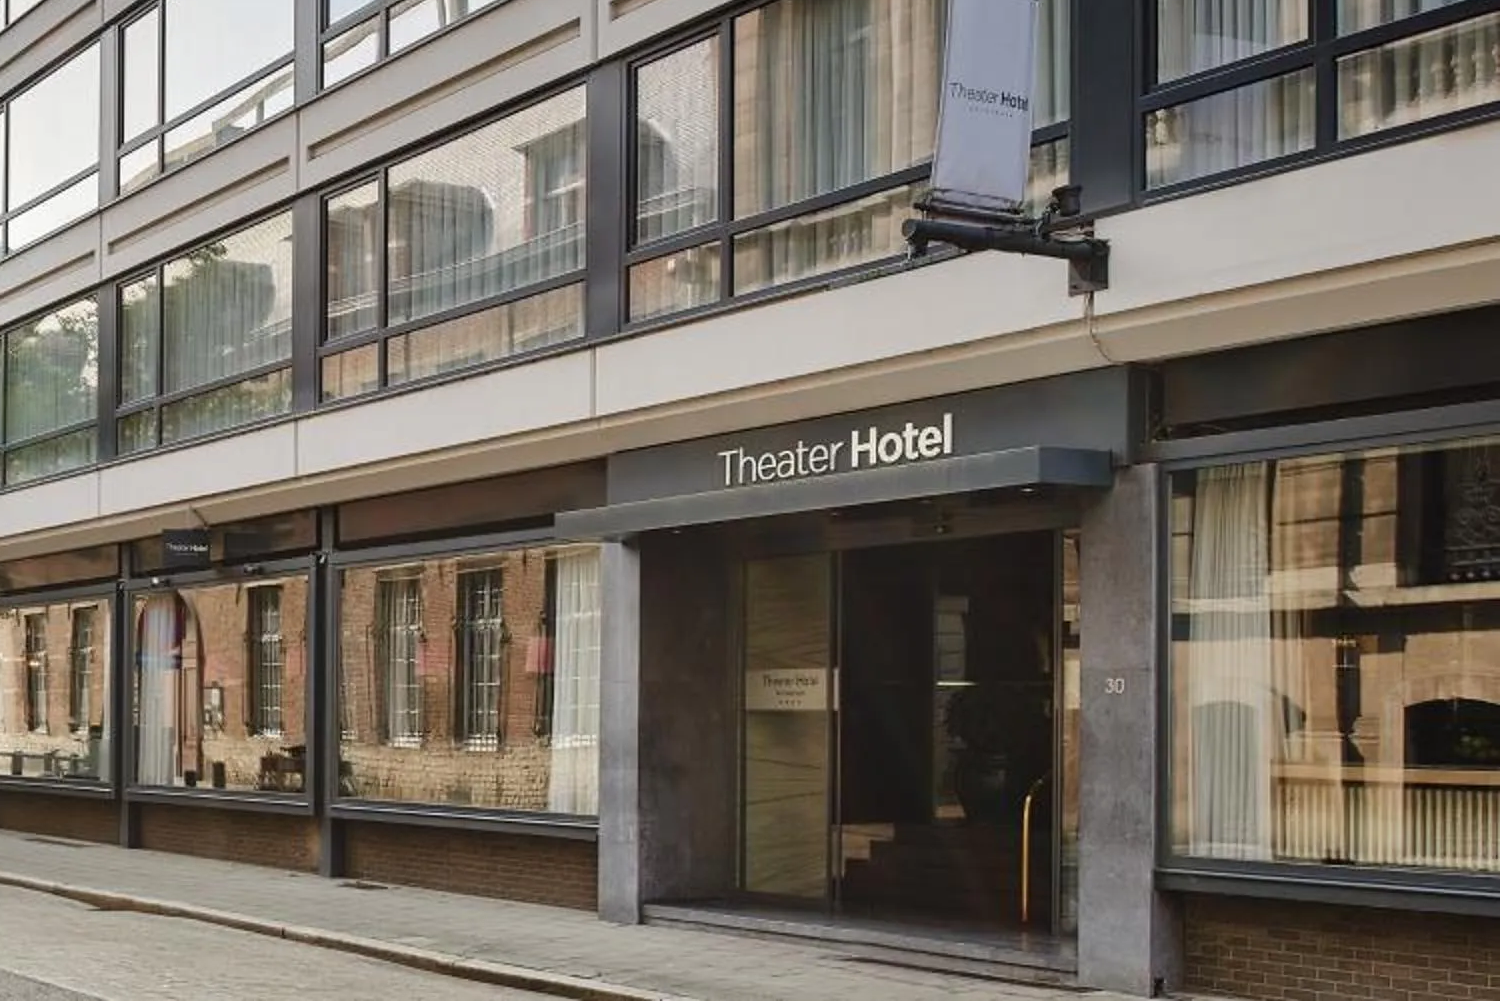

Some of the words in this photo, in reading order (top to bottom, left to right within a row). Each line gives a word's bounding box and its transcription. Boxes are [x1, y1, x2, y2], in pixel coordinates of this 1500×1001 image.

[948, 81, 999, 104] Theater
[1000, 91, 1029, 112] Hotel
[716, 439, 845, 487] Theater
[851, 412, 953, 469] Hotel
[1105, 678, 1125, 694] 30
